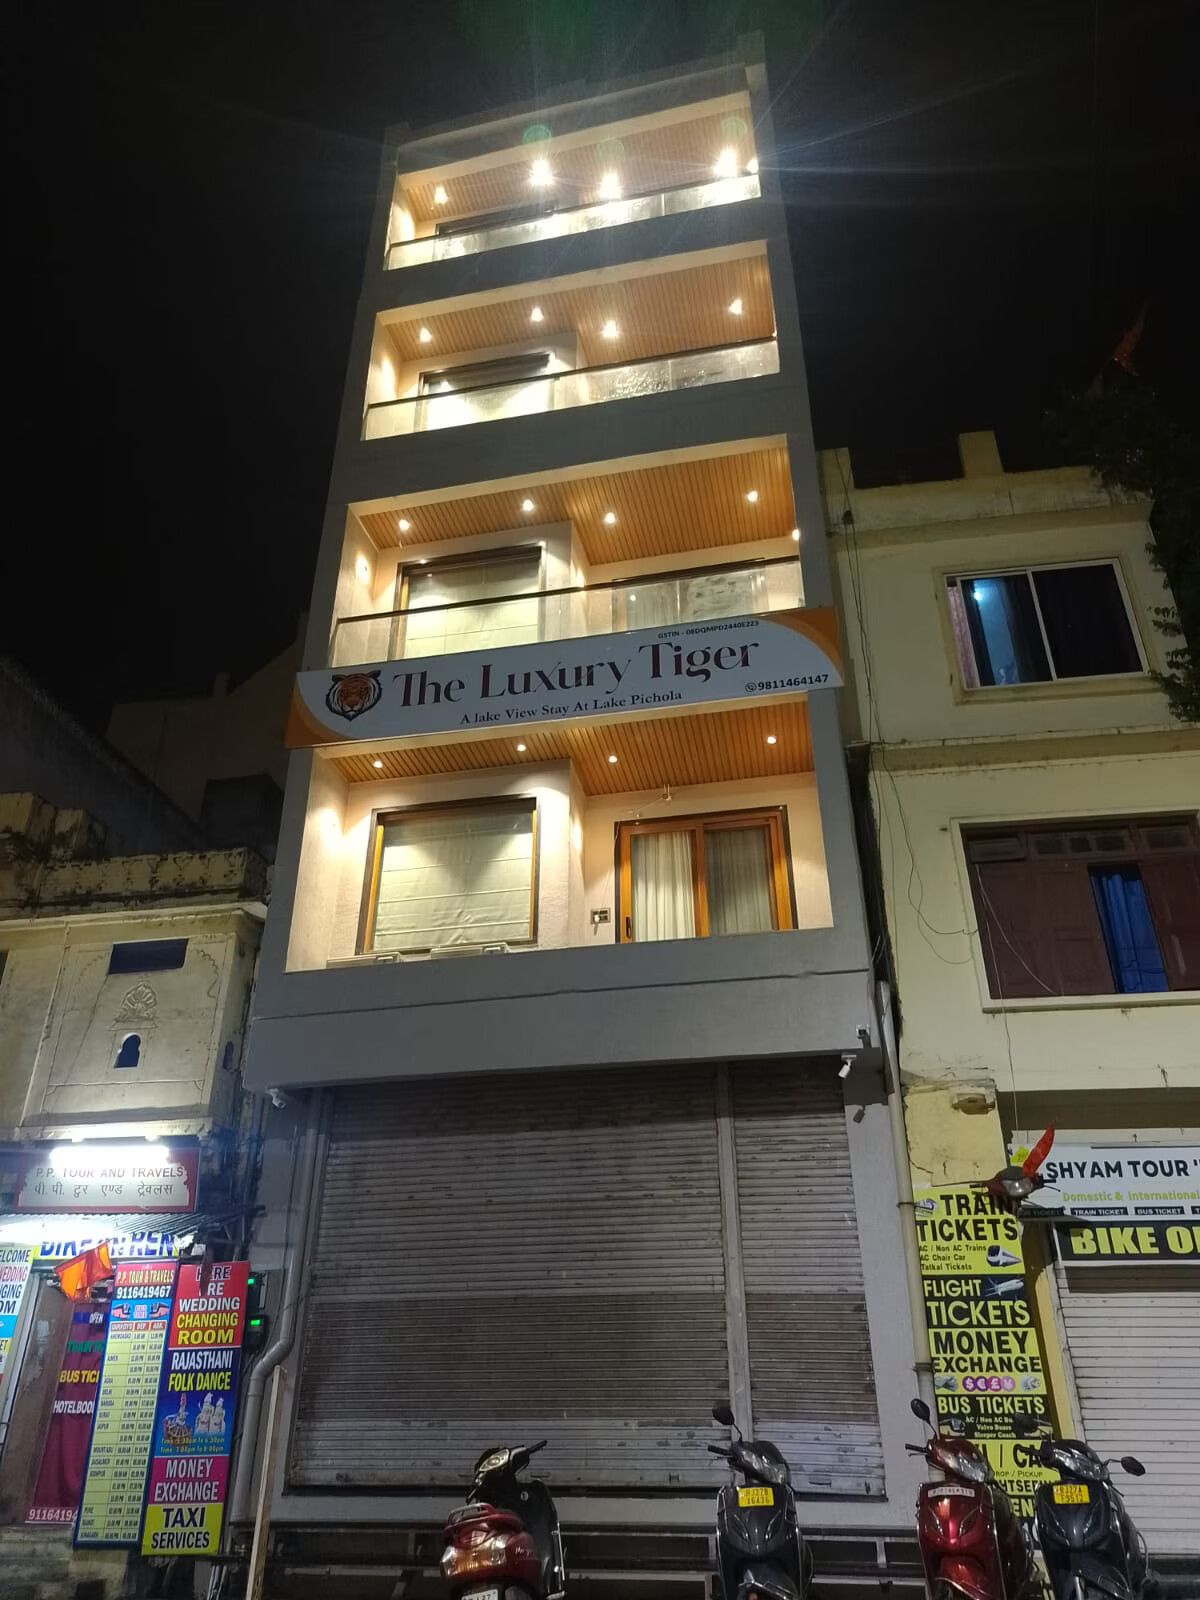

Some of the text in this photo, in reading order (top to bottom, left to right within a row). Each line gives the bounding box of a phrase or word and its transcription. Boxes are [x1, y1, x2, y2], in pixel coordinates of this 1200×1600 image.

[658, 631, 680, 640] GSTIN
[392, 642, 760, 707] The Luxury Tiger
[758, 674, 829, 690] 9811464147
[460, 713, 470, 724] A
[505, 708, 538, 719] View
[541, 704, 569, 716] Stay
[574, 701, 588, 712] At
[593, 695, 626, 709] Lake
[631, 691, 682, 705] Pichola
[63, 1168, 95, 1178] TOUR
[100, 1168, 125, 1178] AND
[131, 1166, 184, 1178] TRAVELS
[1045, 1161, 1123, 1179] SHYAM
[1128, 1160, 1190, 1177] TOUR
[1062, 1192, 1112, 1202] Domestic
[1128, 1190, 1200, 1200] International
[915, 1218, 1018, 1242] TICKETS
[1070, 1227, 1160, 1255] BIKE
[149, 1269, 174, 1283] TRAVELS
[946, 1263, 972, 1271] Tickets
[0, 1284, 22, 1299] GING
[117, 1285, 171, 1299] 9116419467
[923, 1279, 982, 1297] FLIGHT
[179, 1297, 240, 1312] WEDDING
[926, 1300, 1031, 1326] TICKETS
[176, 1312, 239, 1328] CHANGING
[177, 1329, 234, 1345] ROOM
[933, 1330, 1029, 1355] MONEY
[171, 1350, 234, 1371] RAJASTHANI
[932, 1356, 1042, 1373] EXCHANGE
[60, 1370, 81, 1383] BUS
[168, 1371, 232, 1392] FOLK DANCE
[77, 1400, 95, 1413] BOO
[937, 1396, 1045, 1414] BUS TICKETS
[1013, 1443, 1042, 1469] CA
[165, 1458, 213, 1479] MONEY
[154, 1481, 219, 1502] EXCHANGE
[163, 1507, 206, 1528] TAXI
[151, 1531, 210, 1550] SERVICES
